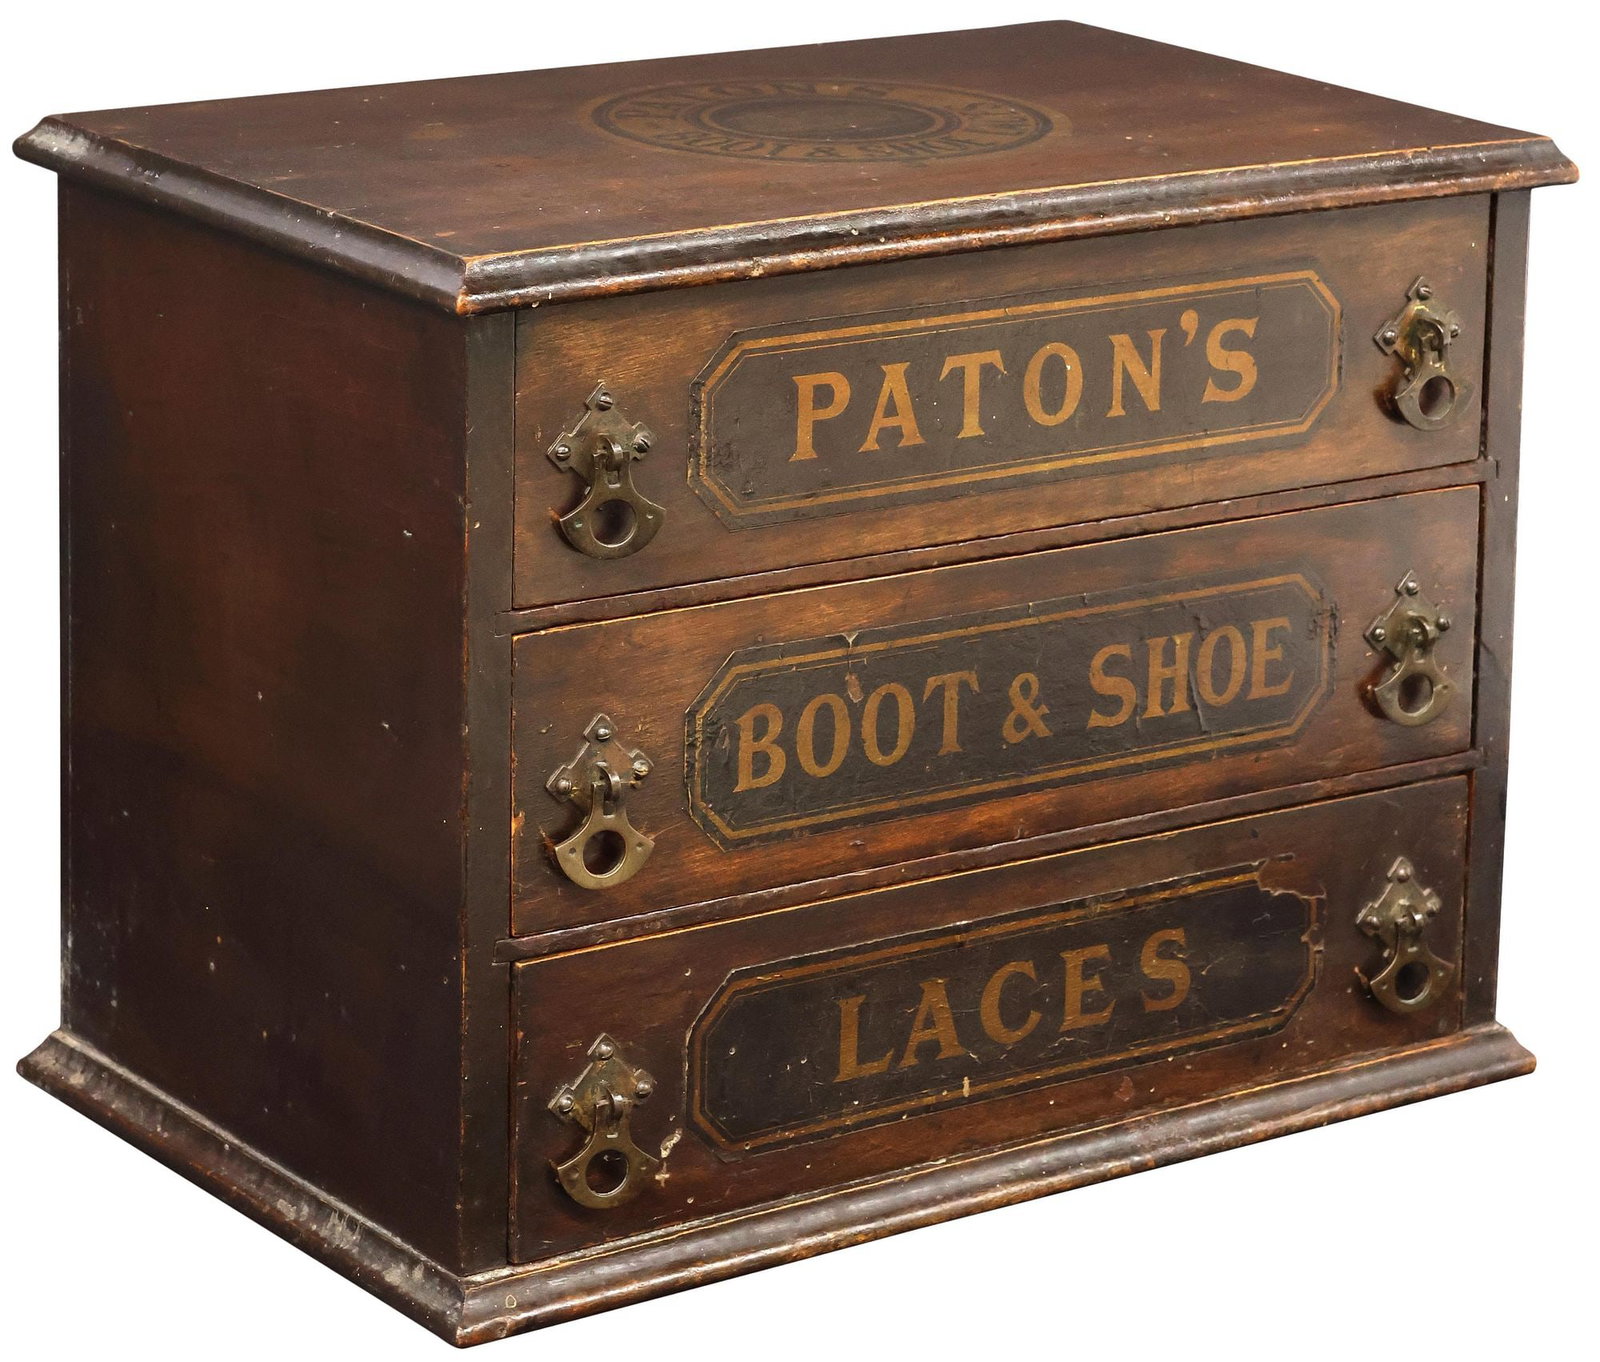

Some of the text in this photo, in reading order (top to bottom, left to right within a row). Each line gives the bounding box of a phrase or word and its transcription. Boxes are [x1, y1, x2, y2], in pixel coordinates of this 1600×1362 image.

[788, 308, 1260, 462] PATON'S
[733, 616, 1296, 794] BOOT & SHOE
[833, 927, 1193, 1084] LACES
